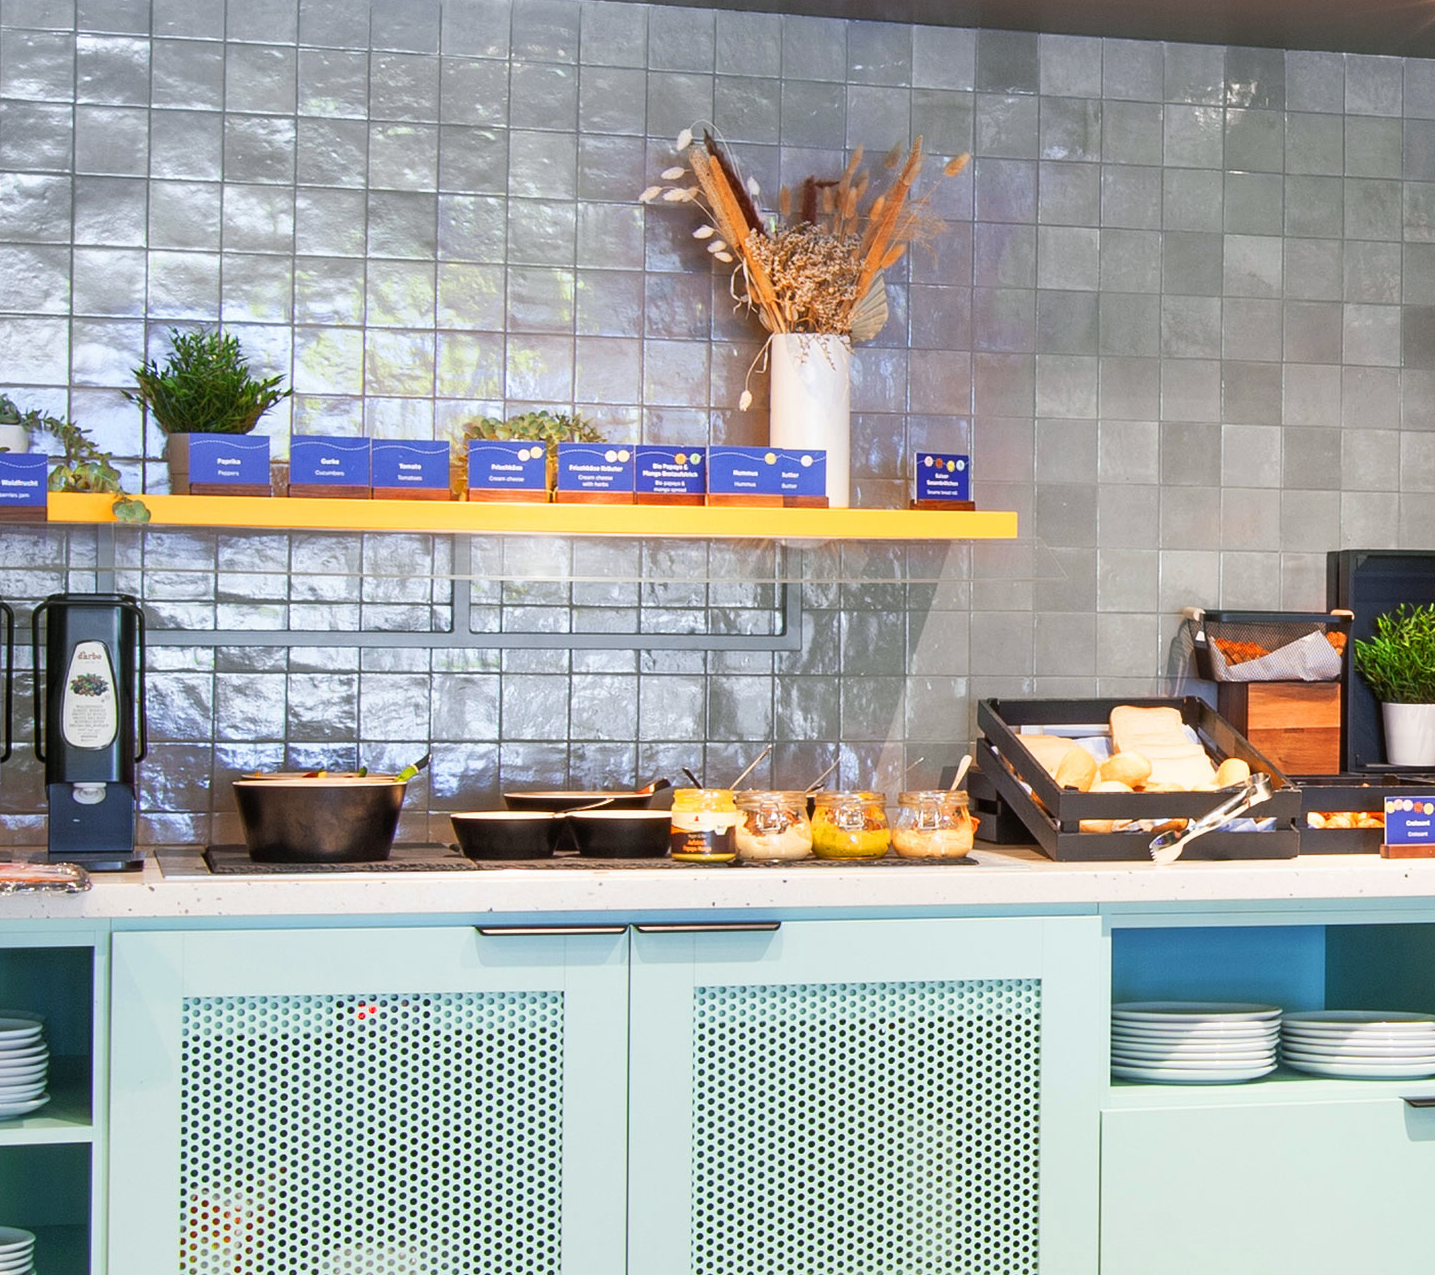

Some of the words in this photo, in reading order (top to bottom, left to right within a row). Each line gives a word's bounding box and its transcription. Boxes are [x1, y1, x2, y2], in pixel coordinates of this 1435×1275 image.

[217, 457, 242, 466] Paprika
[320, 457, 340, 465] Gurke
[398, 463, 422, 471] Tomate
[314, 469, 345, 477] Cucumbers
[732, 469, 759, 477] Hummus
[1, 479, 39, 488] Waldfrucht
[1406, 819, 1431, 827] Croissant
